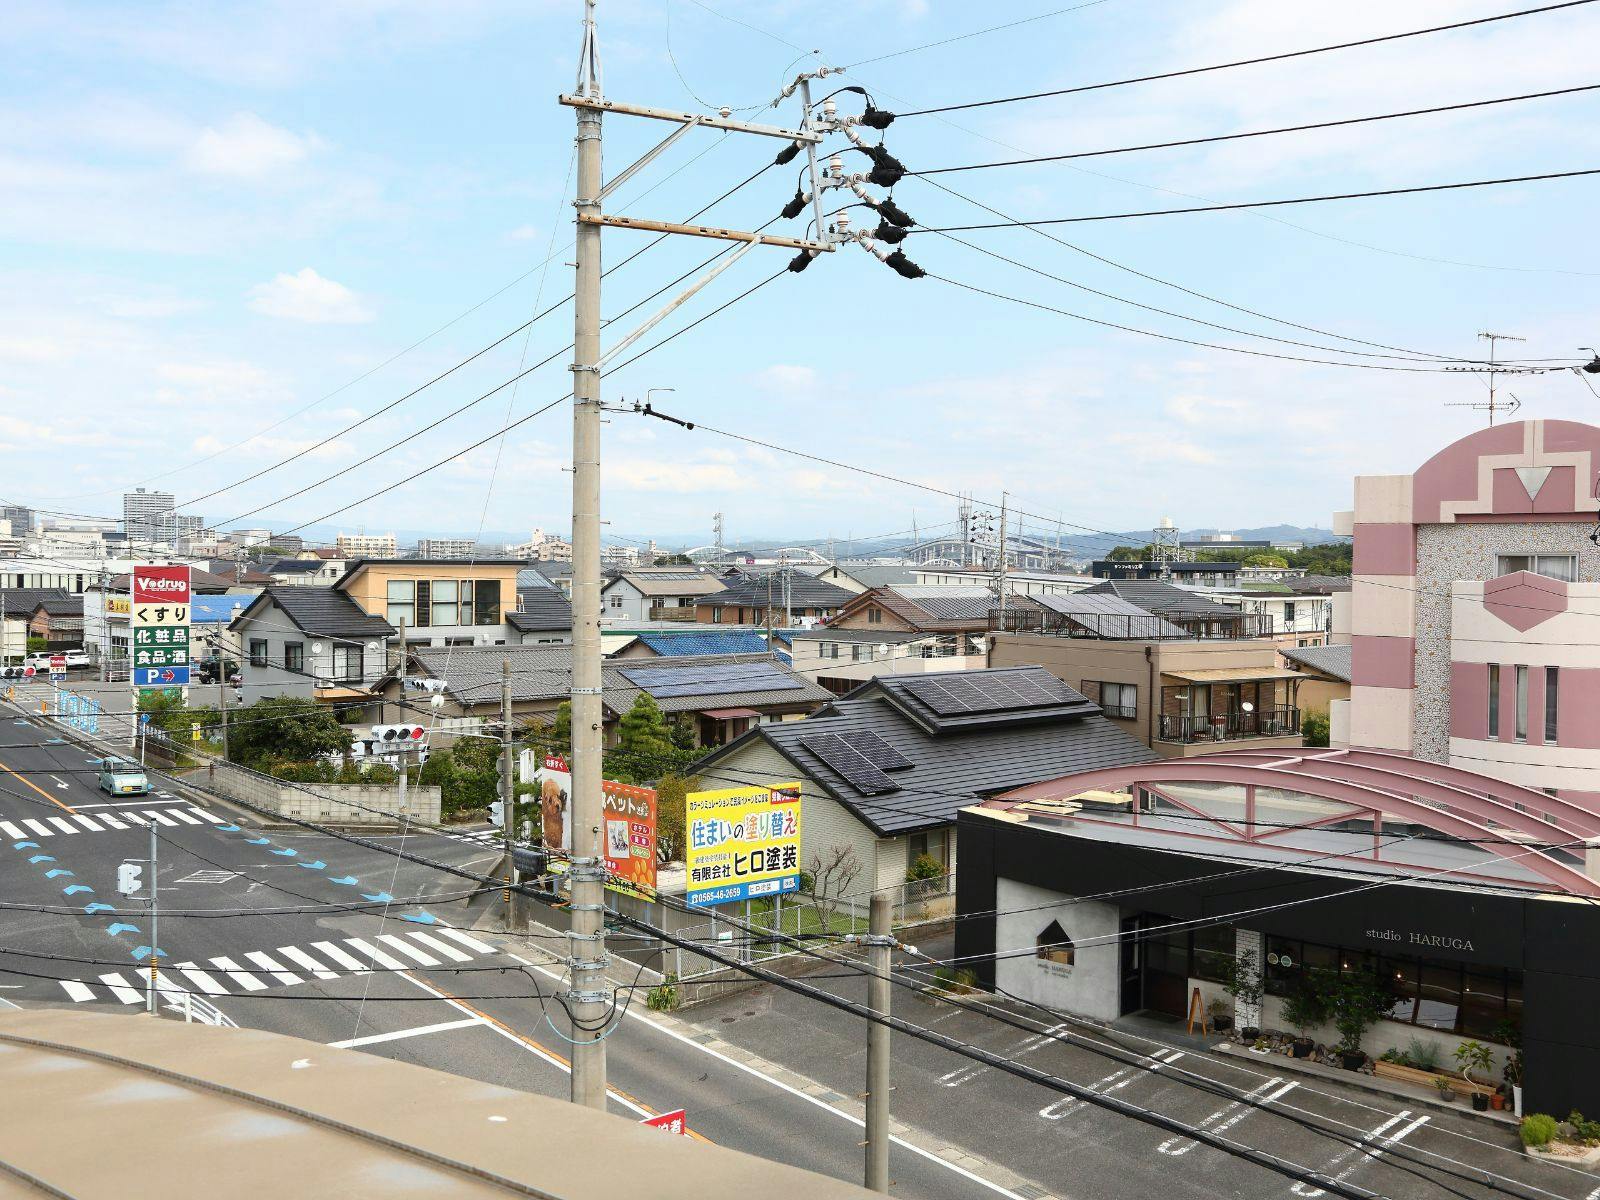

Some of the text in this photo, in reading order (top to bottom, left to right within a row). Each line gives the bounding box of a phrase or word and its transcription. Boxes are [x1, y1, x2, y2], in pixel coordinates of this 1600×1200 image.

[137, 607, 186, 622] くすり
[136, 629, 187, 644] 化粧品
[147, 669, 159, 683] P
[691, 810, 798, 848] 住まいの塗り替え
[691, 864, 731, 882] 有限会社
[734, 845, 797, 875] ヒロ塗装
[1366, 929, 1475, 952] studio HARUGA
